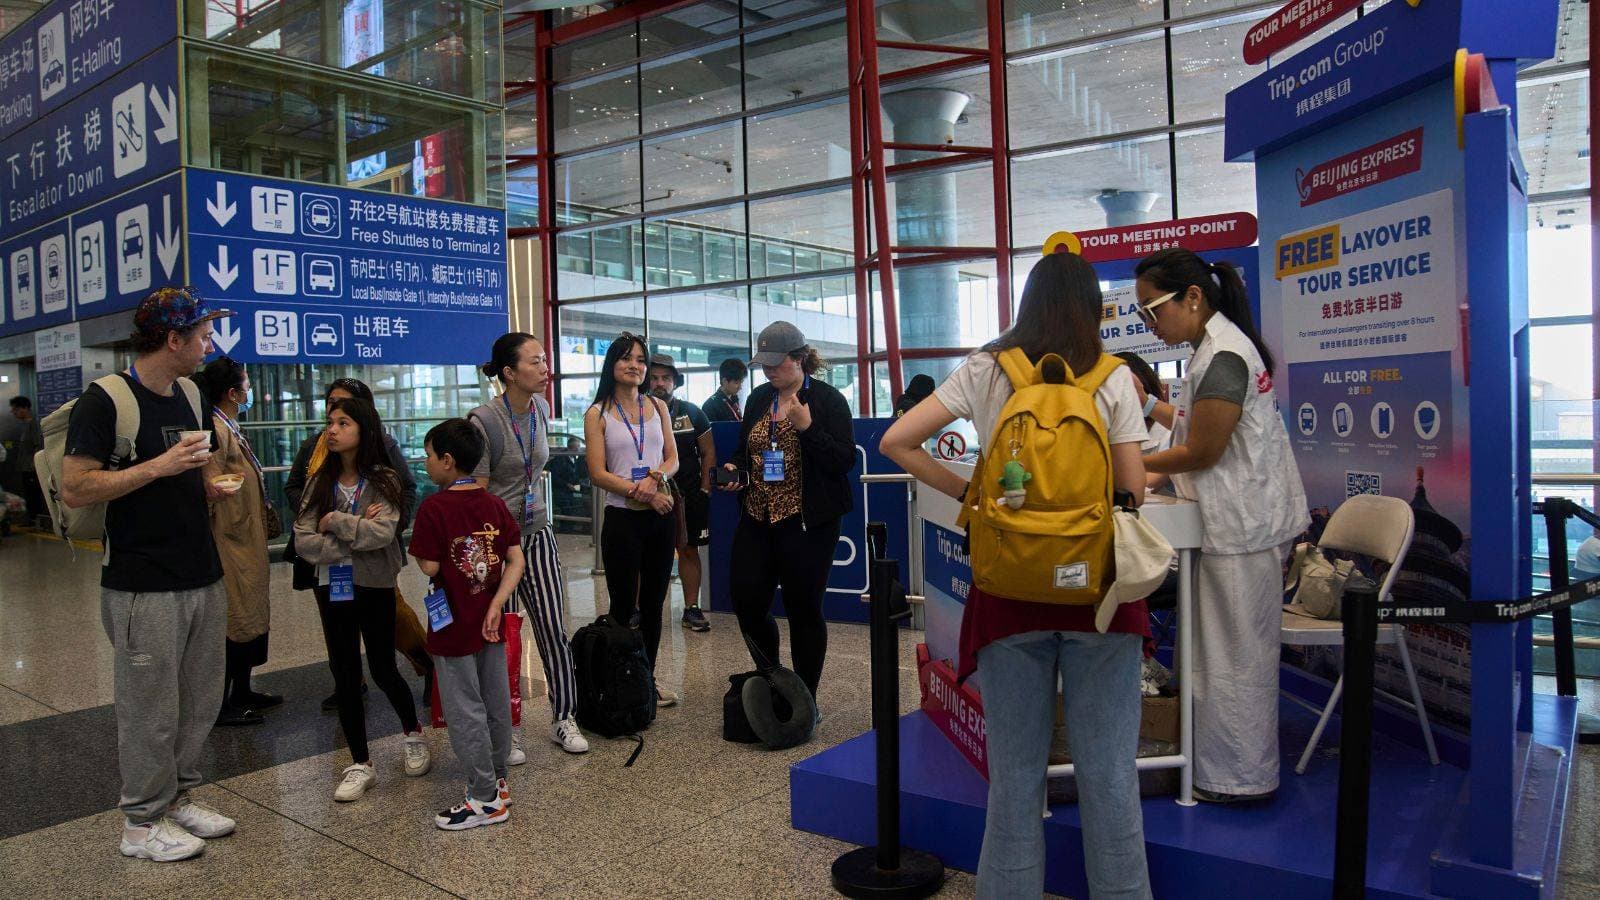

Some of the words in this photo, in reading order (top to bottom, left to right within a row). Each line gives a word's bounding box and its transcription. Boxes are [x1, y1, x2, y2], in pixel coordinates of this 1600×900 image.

[1249, 18, 1279, 47] TOUR
[72, 36, 121, 84] E-Hailing
[1268, 56, 1332, 100] Trip.com
[1334, 29, 1385, 66] Group
[0, 94, 32, 127] Parking
[1295, 77, 1351, 117] 携程集团
[7, 108, 102, 190] 下行扶梯
[1312, 159, 1358, 188] BEIJING
[1361, 138, 1415, 171] EXPRESS
[9, 184, 63, 222] Escalator
[68, 165, 103, 197] Down
[259, 192, 289, 215] 1F
[265, 219, 283, 230] 一层
[349, 199, 500, 237] 开往2号航站楼免费摆渡车
[351, 227, 379, 244] Free
[382, 230, 430, 249] Shuttles
[432, 236, 444, 250] to
[446, 237, 491, 254] Terminal
[493, 242, 501, 255] 2
[1080, 233, 1120, 248] TOUR
[1122, 225, 1186, 243] MEETING
[1190, 219, 1238, 236] POINT
[1279, 232, 1334, 271] FREE
[1341, 215, 1432, 255] LAYOVER
[81, 231, 102, 273] B1
[260, 253, 291, 276] 1F
[266, 280, 284, 291] 一层
[1297, 271, 1342, 296] TOUR
[1348, 252, 1432, 287] SERVICE
[351, 285, 369, 300] Local
[402, 288, 418, 303] Gate
[427, 290, 450, 308] Intercity
[480, 293, 493, 307] Gate
[1321, 291, 1404, 320] 免费北京半日游
[261, 315, 290, 338] B1
[353, 315, 410, 338] 出租车
[1417, 316, 1435, 325] hours
[260, 342, 295, 352] 地下一层
[354, 343, 382, 358] Taxi
[1323, 371, 1343, 384] ALL
[1344, 370, 1367, 383] FOR
[930, 671, 966, 723] BEIJING
